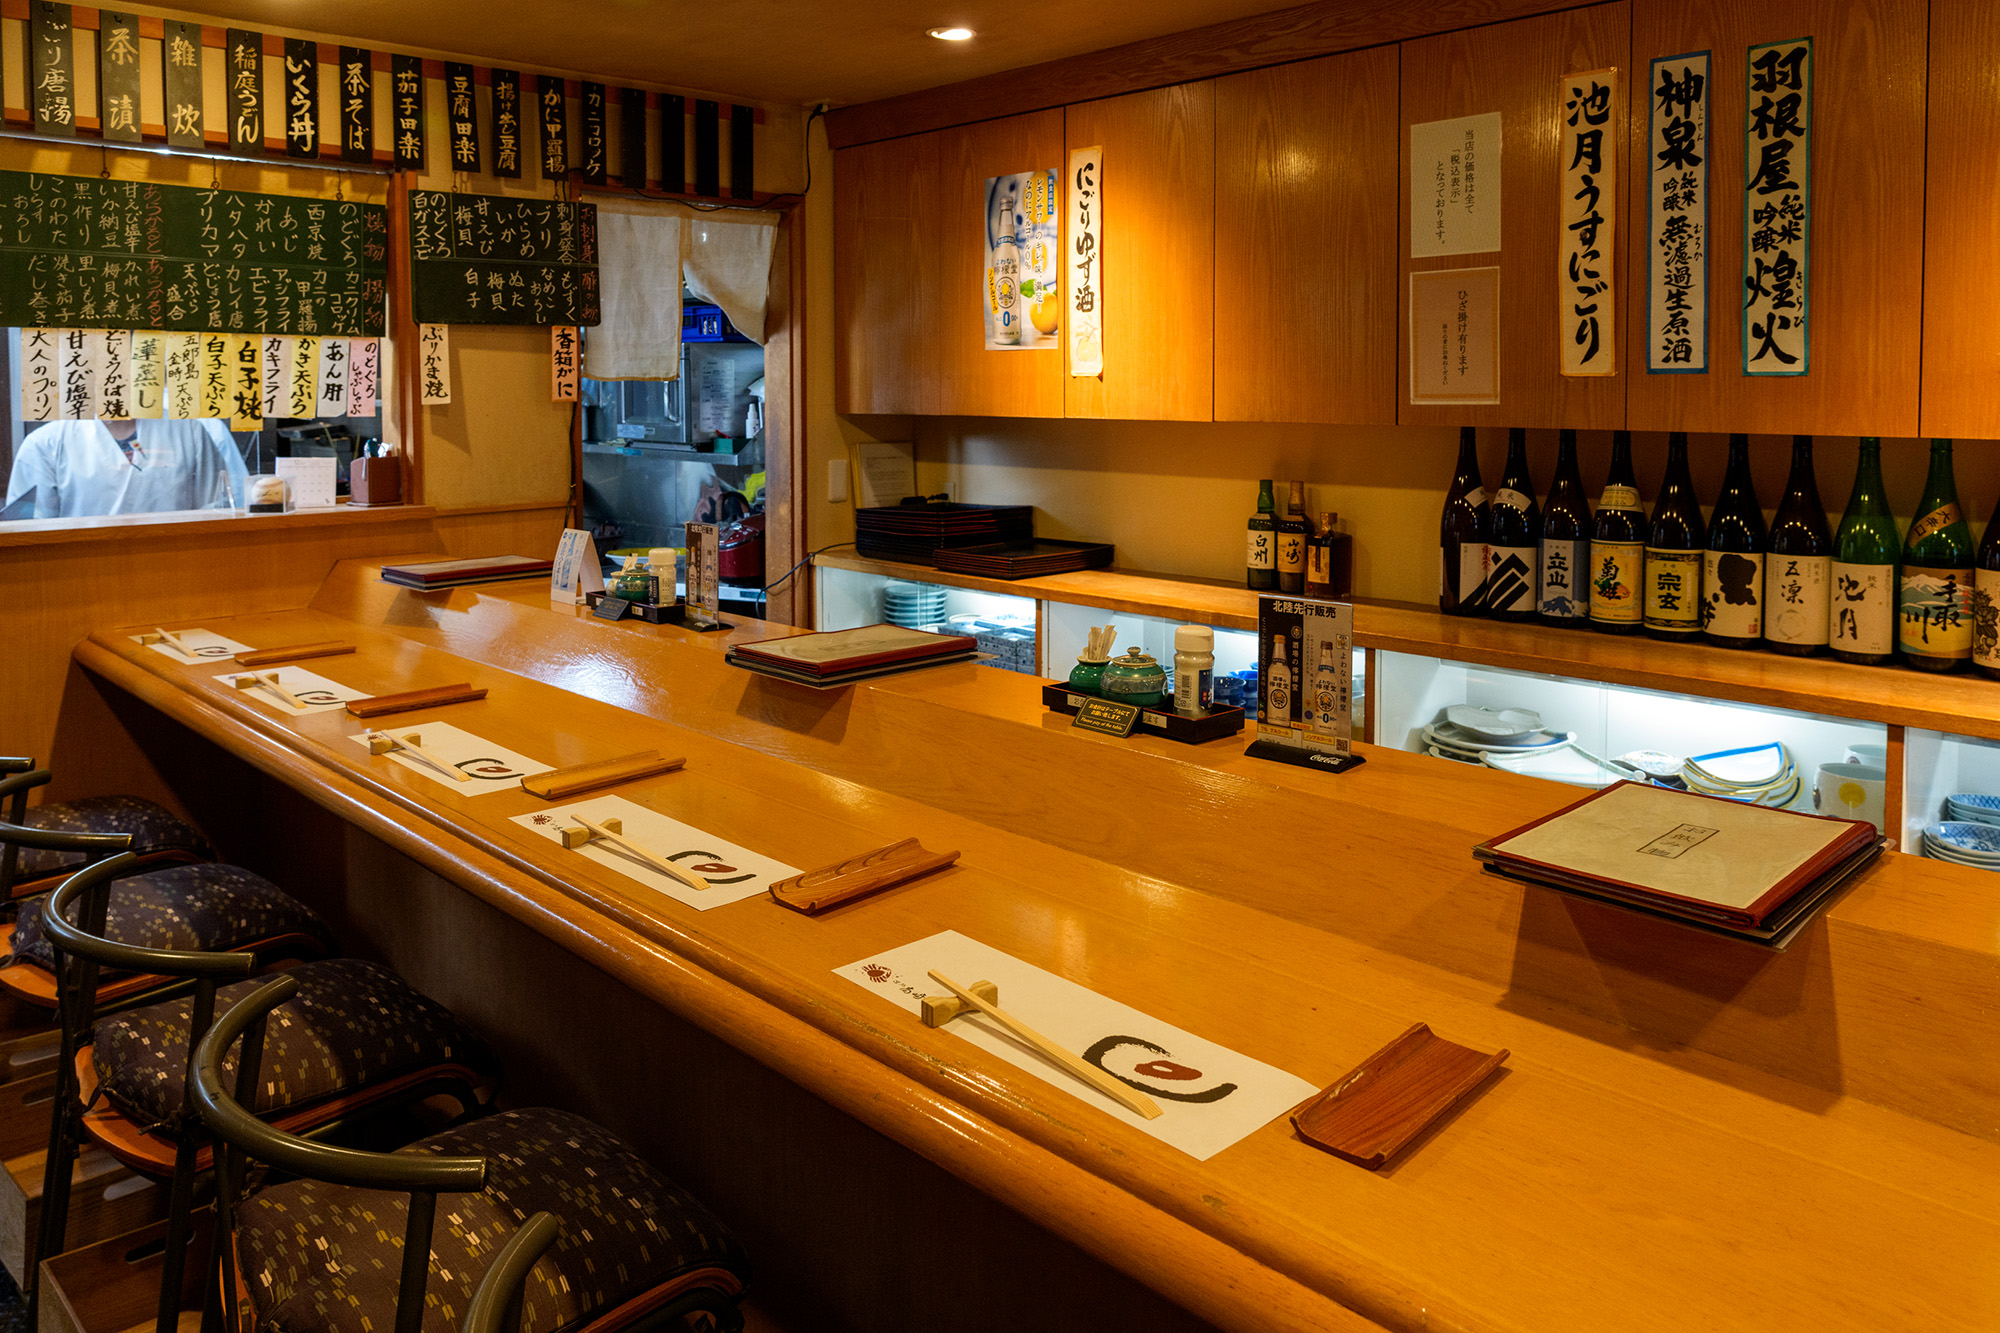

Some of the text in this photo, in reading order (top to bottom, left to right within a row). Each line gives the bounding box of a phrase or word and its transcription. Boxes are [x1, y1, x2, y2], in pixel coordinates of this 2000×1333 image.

[106, 28, 138, 133] 茶漬
[170, 35, 200, 137] 雑炊
[234, 44, 259, 144] 稲庭うどん
[286, 55, 315, 152] いくら丼
[343, 62, 370, 150] 茶そば
[397, 70, 421, 159] 茄子田楽
[451, 76, 476, 164] 豆腐田楽
[496, 81, 518, 171] 揚げ出し豆腐
[544, 90, 566, 173] かに甲羅揚
[586, 92, 601, 176] カニコロッケ
[1655, 66, 1704, 172] 神泉
[1746, 46, 1807, 195] 羽根屋
[30, 173, 44, 224] しらす
[1436, 160, 1446, 244] となっております。
[1450, 148, 1460, 204] 「税込表示」
[1465, 129, 1475, 214] 当店の価格は全て
[1680, 171, 1699, 207] 純米
[13, 194, 31, 243] おろし
[50, 176, 68, 244] このわた
[73, 182, 92, 245] 黒作り
[99, 184, 121, 248] いか納豆
[122, 182, 142, 253] 甘えび塩辛
[143, 184, 163, 253] あらかると
[196, 190, 221, 257] ブリカマ
[226, 194, 249, 259] ハタハタ
[255, 199, 275, 252] かれい
[279, 206, 299, 253] あじ
[307, 203, 328, 261] 西京焼
[339, 203, 360, 267] のどぐろ
[413, 191, 434, 261] 白ガスエビ
[430, 193, 451, 258] のどぐろ
[454, 205, 474, 247] 梅貝
[474, 197, 494, 255] 甘えび
[496, 211, 517, 244] いか
[516, 203, 535, 258] ひらめ
[536, 205, 551, 249] ブリ
[556, 203, 577, 265] 刺身盛合
[580, 205, 595, 264] お刺身
[1076, 162, 1096, 313] にごりゆず酒
[1566, 81, 1611, 365] 池月うすにごり
[1778, 194, 1806, 244] 純米
[28, 254, 51, 325] だし巻き
[53, 254, 76, 323] 焼き茄子
[78, 256, 100, 320] 里いも煮
[123, 260, 144, 321] かれい煮
[146, 258, 164, 327] あらかると
[167, 284, 187, 321] 盛合
[182, 263, 200, 314] 天ぷら
[249, 267, 271, 333] エビフライ
[272, 268, 293, 333] アジフライ
[295, 280, 318, 332] 甲羅揚
[312, 269, 328, 307] カニの
[330, 293, 347, 333] コロッケ
[464, 267, 481, 309] 白子
[486, 271, 507, 312] 梅貝
[508, 270, 525, 308] ぬた
[530, 281, 547, 324] おろし
[541, 266, 556, 309] なめこ
[560, 271, 578, 322] もずく
[1659, 215, 1696, 363] 無濾過生原酒
[1744, 250, 1800, 364] 煌火
[1794, 271, 1805, 328] きらび
[183, 334, 200, 380] 五郎島
[422, 326, 449, 399] ぶりかま焼
[553, 327, 576, 398] 香箱がに
[1457, 290, 1468, 376] ひざ掛け有ります
[29, 330, 58, 421] 大人のプリン
[65, 330, 94, 420] 甘えび塩辛
[100, 329, 129, 419] どじょうかば焼
[168, 352, 184, 382] 金時
[206, 335, 228, 418] 白子天ぷら
[233, 340, 263, 421] 白子焼
[264, 337, 282, 414] カキフライ
[290, 337, 316, 416] かき天ぷら
[322, 341, 344, 402] あん肝
[349, 361, 362, 416] しゃぶしゃぶ
[364, 341, 378, 399] のどぐろ
[175, 382, 194, 420] 天ぷら
[1254, 534, 1268, 565] 白州
[1286, 538, 1301, 565] 山崎
[1914, 508, 1951, 538] 大辛口
[1546, 551, 1569, 589] 立山
[1657, 572, 1682, 611] 宗玄
[1272, 600, 1337, 619] 北陸先行販売
[1834, 573, 1866, 640] 池月
[1905, 573, 1964, 645] 手取川
